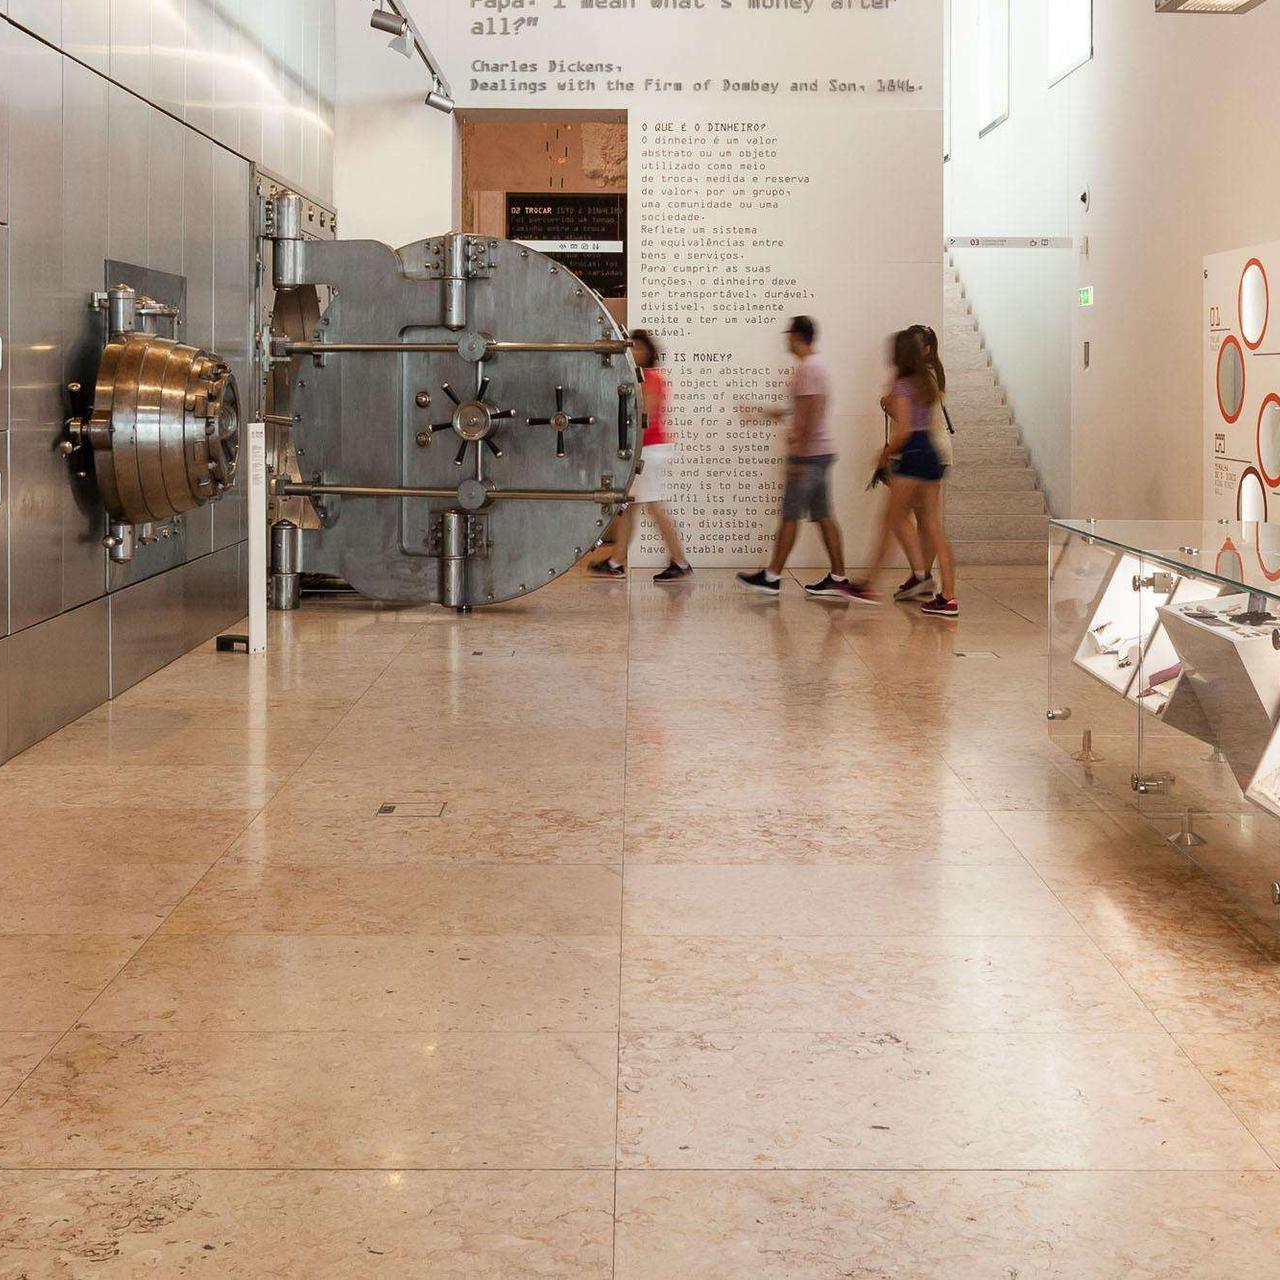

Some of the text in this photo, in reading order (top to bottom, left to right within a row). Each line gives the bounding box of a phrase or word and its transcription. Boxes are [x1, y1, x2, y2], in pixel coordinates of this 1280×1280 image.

[471, 58, 622, 73] Charles Dickens,
[470, 79, 547, 94] Dealings
[557, 79, 595, 93] with
[607, 80, 635, 91] the
[644, 79, 682, 93] Firm
[693, 79, 713, 92] of
[721, 79, 779, 94] Dombey
[790, 79, 818, 94] and
[827, 79, 865, 94] Son,
